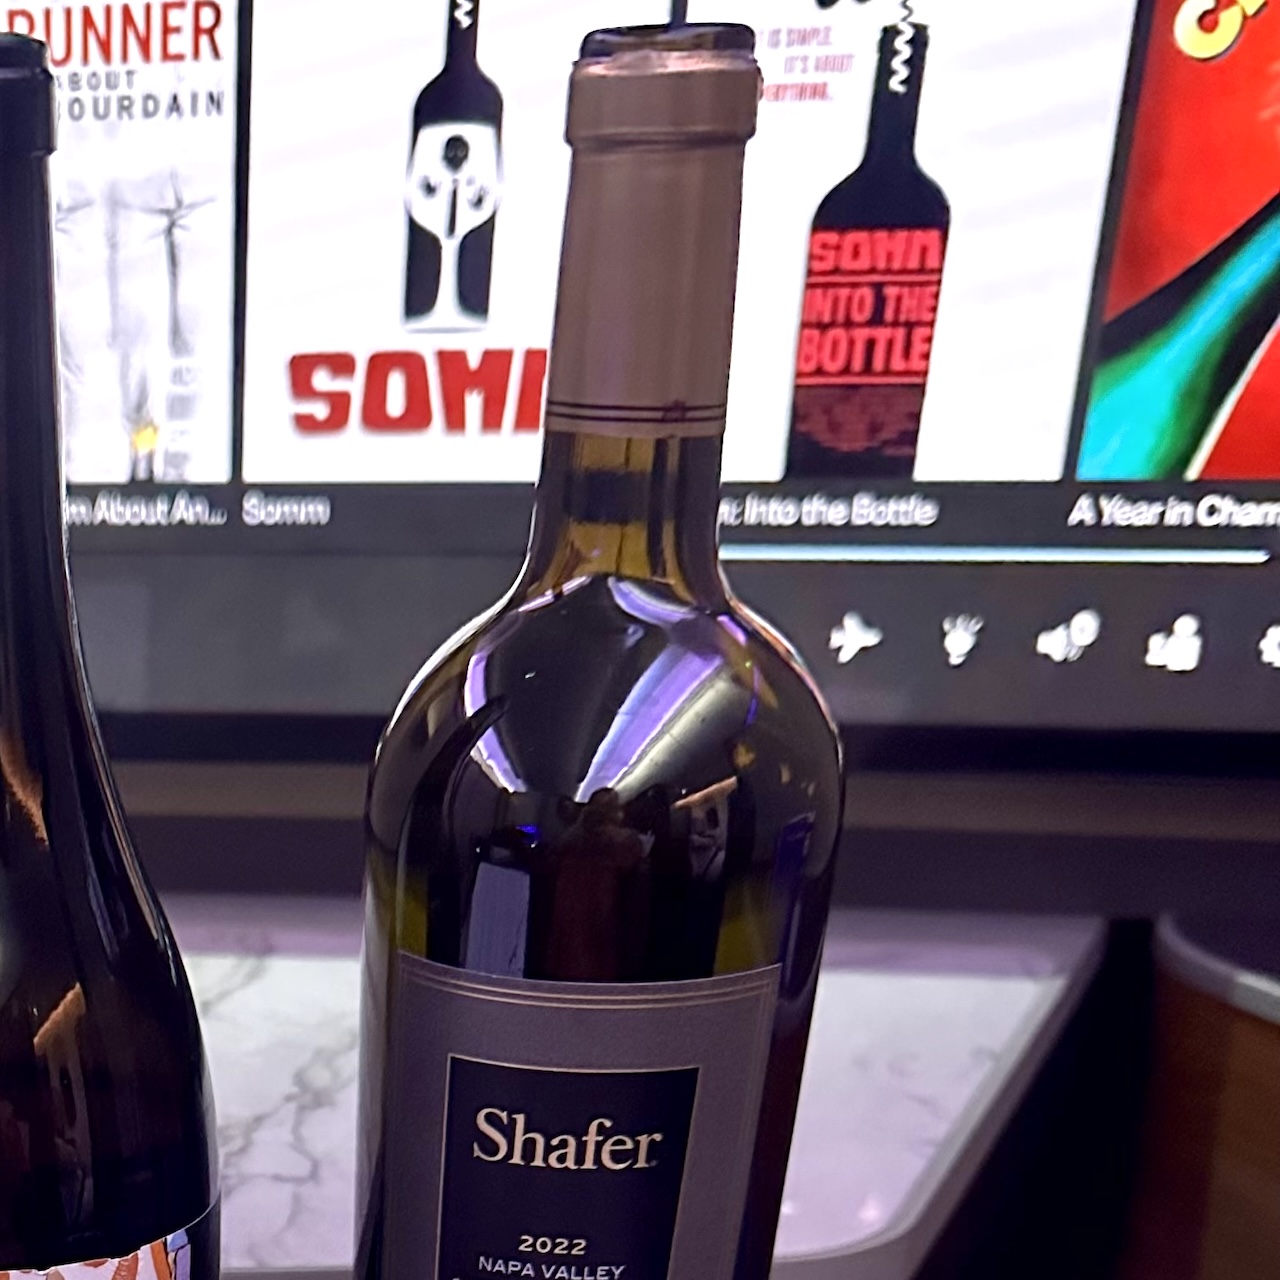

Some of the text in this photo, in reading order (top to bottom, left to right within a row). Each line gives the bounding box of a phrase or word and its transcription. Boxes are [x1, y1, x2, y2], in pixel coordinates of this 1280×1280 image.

[54, 70, 136, 92] BOUT
[57, 91, 224, 122] OURDAIN
[801, 284, 939, 324] INTO THE
[794, 325, 934, 374] BOTTLE
[241, 488, 331, 527] Somm
[743, 494, 801, 527] Into
[800, 494, 850, 527] the
[851, 492, 941, 527] Bottle
[1067, 493, 1097, 526] A
[1099, 493, 1165, 527] Year
[1163, 495, 1194, 527] in
[473, 1107, 664, 1170] Shafer
[518, 1235, 587, 1255] 2022
[478, 1255, 626, 1280] NAPA VALLEY
